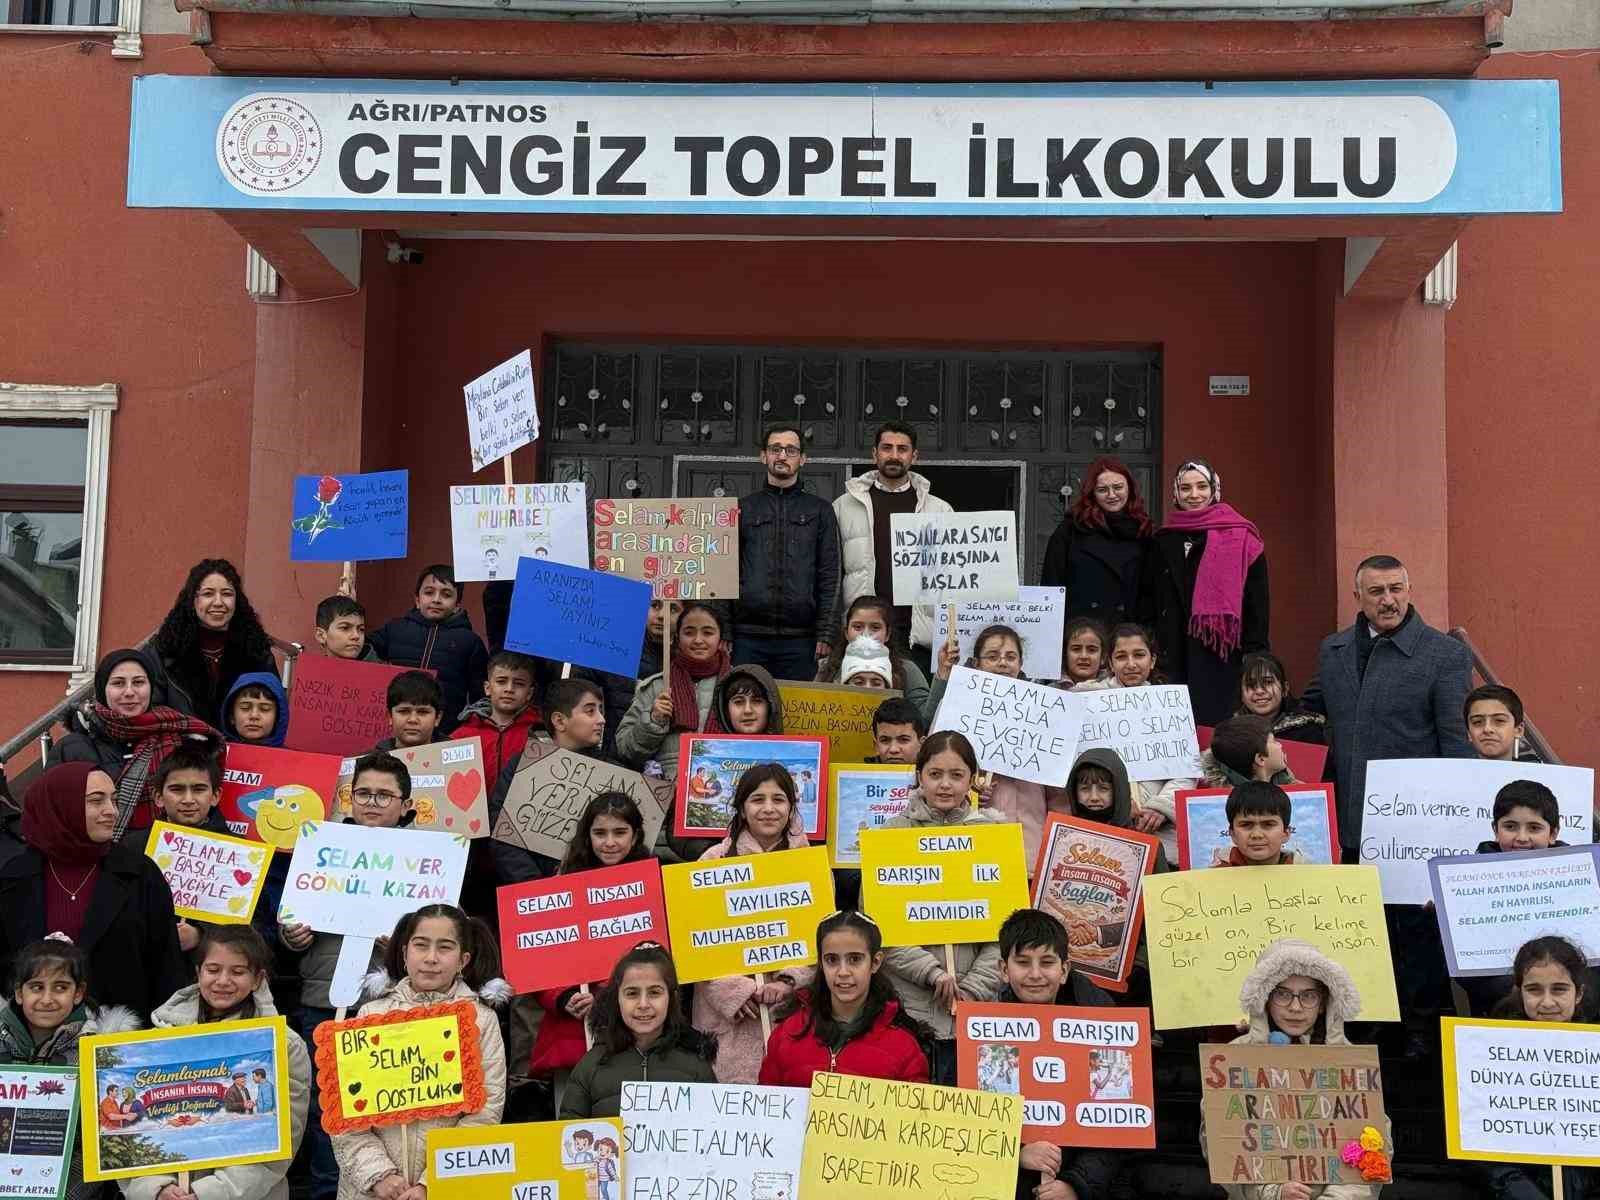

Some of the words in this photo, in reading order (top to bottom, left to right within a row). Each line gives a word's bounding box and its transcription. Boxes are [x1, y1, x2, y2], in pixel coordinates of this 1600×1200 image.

[348, 99, 547, 123] AĞRI/PATNOS
[338, 120, 647, 197] CENGİZ
[675, 135, 936, 198] TOPEL
[967, 122, 1398, 198] İLKOKULU
[595, 555, 625, 572] en
[643, 554, 705, 578] güzel
[940, 550, 1000, 569] BAŞINDA
[921, 572, 980, 592] BAŞLAR
[967, 674, 1066, 713] SELAMLA
[1100, 691, 1153, 713] SELAM
[980, 697, 1049, 729] BAŞLA
[959, 714, 1065, 756] SEVGİYLE
[1118, 718, 1131, 738] O
[979, 737, 1041, 772] YAŞA
[223, 770, 261, 786] ELAM
[866, 784, 888, 798] Bir
[1366, 792, 1418, 818] Selam
[170, 836, 237, 866] SELAMLA
[919, 836, 974, 852] SELAM
[316, 846, 394, 871] SELAM
[1063, 842, 1123, 873] Selam
[295, 870, 371, 895] GÖNÜL
[382, 879, 449, 900] KAZAN
[692, 866, 752, 888] SELAM
[876, 866, 941, 884] BARIŞIN
[975, 864, 1001, 881] İLK
[1061, 880, 1116, 906] bağlar
[1487, 884, 1530, 896] KATINDA
[1532, 877, 1592, 890] İNSANLARIN
[518, 893, 572, 914] SELAM
[729, 888, 813, 913] YAYILIRSA
[907, 904, 986, 921] ADIMIDIR
[1160, 886, 1253, 923] Selamla
[1263, 883, 1325, 911] başlar
[1336, 885, 1368, 906] her
[1491, 900, 1505, 909] EN
[588, 914, 653, 938] BAĞLAR
[1457, 914, 1498, 926] SELAMI
[1500, 910, 1531, 923] ÖNCE
[691, 921, 787, 947] MUHABBET
[1158, 925, 1210, 948] güzel
[1264, 916, 1297, 935] Bir
[1313, 914, 1369, 932] kelime
[747, 941, 803, 965] ARTAR
[1171, 952, 1201, 969] bir
[970, 1021, 1035, 1039] SELAM
[1059, 1022, 1135, 1046] BARIŞIN
[1488, 1046, 1540, 1063] SELAM
[1034, 1061, 1060, 1080] VE
[1205, 1054, 1291, 1089] SELAM
[1299, 1067, 1381, 1090] VERMEK
[1470, 1067, 1525, 1086] DÜNYA
[186, 1082, 220, 1098] İNSANA
[375, 1082, 453, 1113] DOSTLUK
[620, 1082, 692, 1113] SELAM
[711, 1088, 796, 1121] VERMEK
[811, 1072, 876, 1110] SELAM,
[883, 1084, 1014, 1123] MÜSLÜMANLAR
[1079, 1106, 1148, 1124] ADIDIR
[1225, 1092, 1370, 1120] ARANIZDAKİ
[1488, 1095, 1559, 1112] KALPLER
[805, 1109, 887, 1142] ARASINDA
[1241, 1121, 1338, 1152] SEVGİYİ
[1482, 1118, 1557, 1136] DOSTLUK
[444, 1147, 511, 1171] SELAM
[821, 1152, 923, 1190] İŞARETİDİR
[1231, 1154, 1345, 1184] ARTTIRIR
